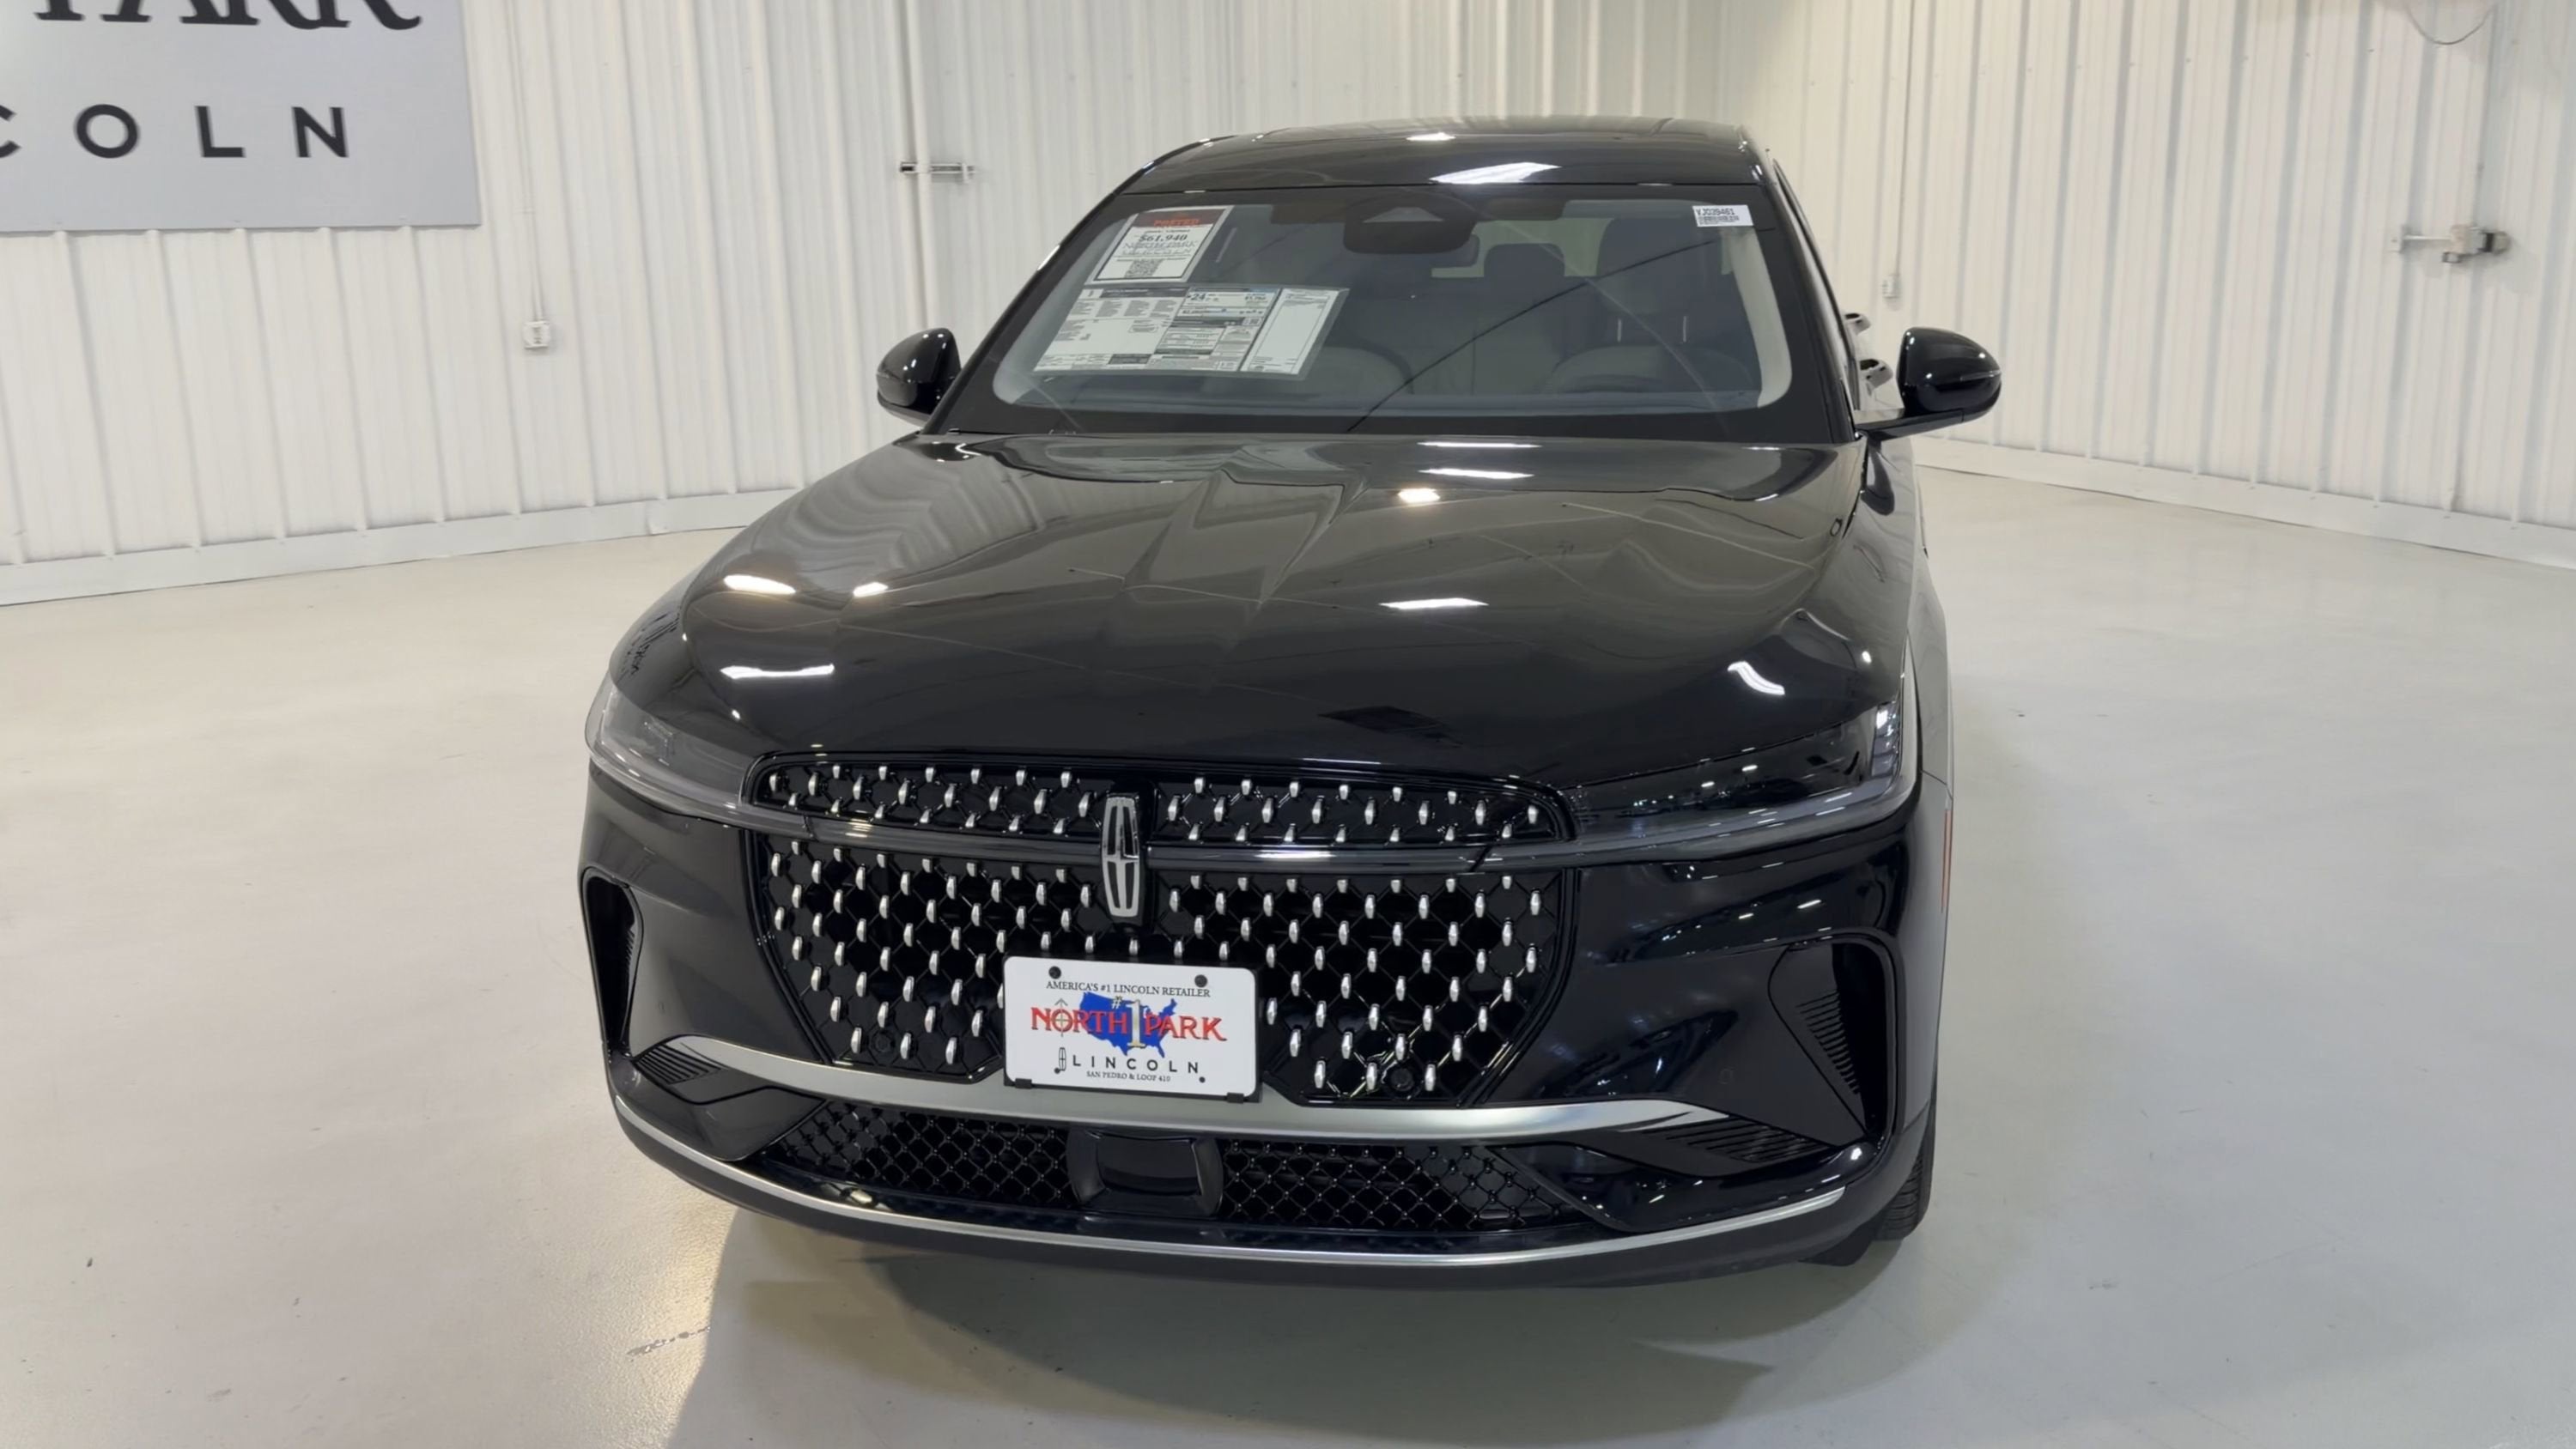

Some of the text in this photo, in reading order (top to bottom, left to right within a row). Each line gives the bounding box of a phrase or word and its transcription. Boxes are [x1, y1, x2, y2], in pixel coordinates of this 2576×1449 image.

[1046, 980, 1211, 997] AMERICA'S #1 LINCOLN RETAILER
[1030, 1007, 1227, 1042] NORTH PARK
[1072, 1054, 1199, 1073] LINCOLN
